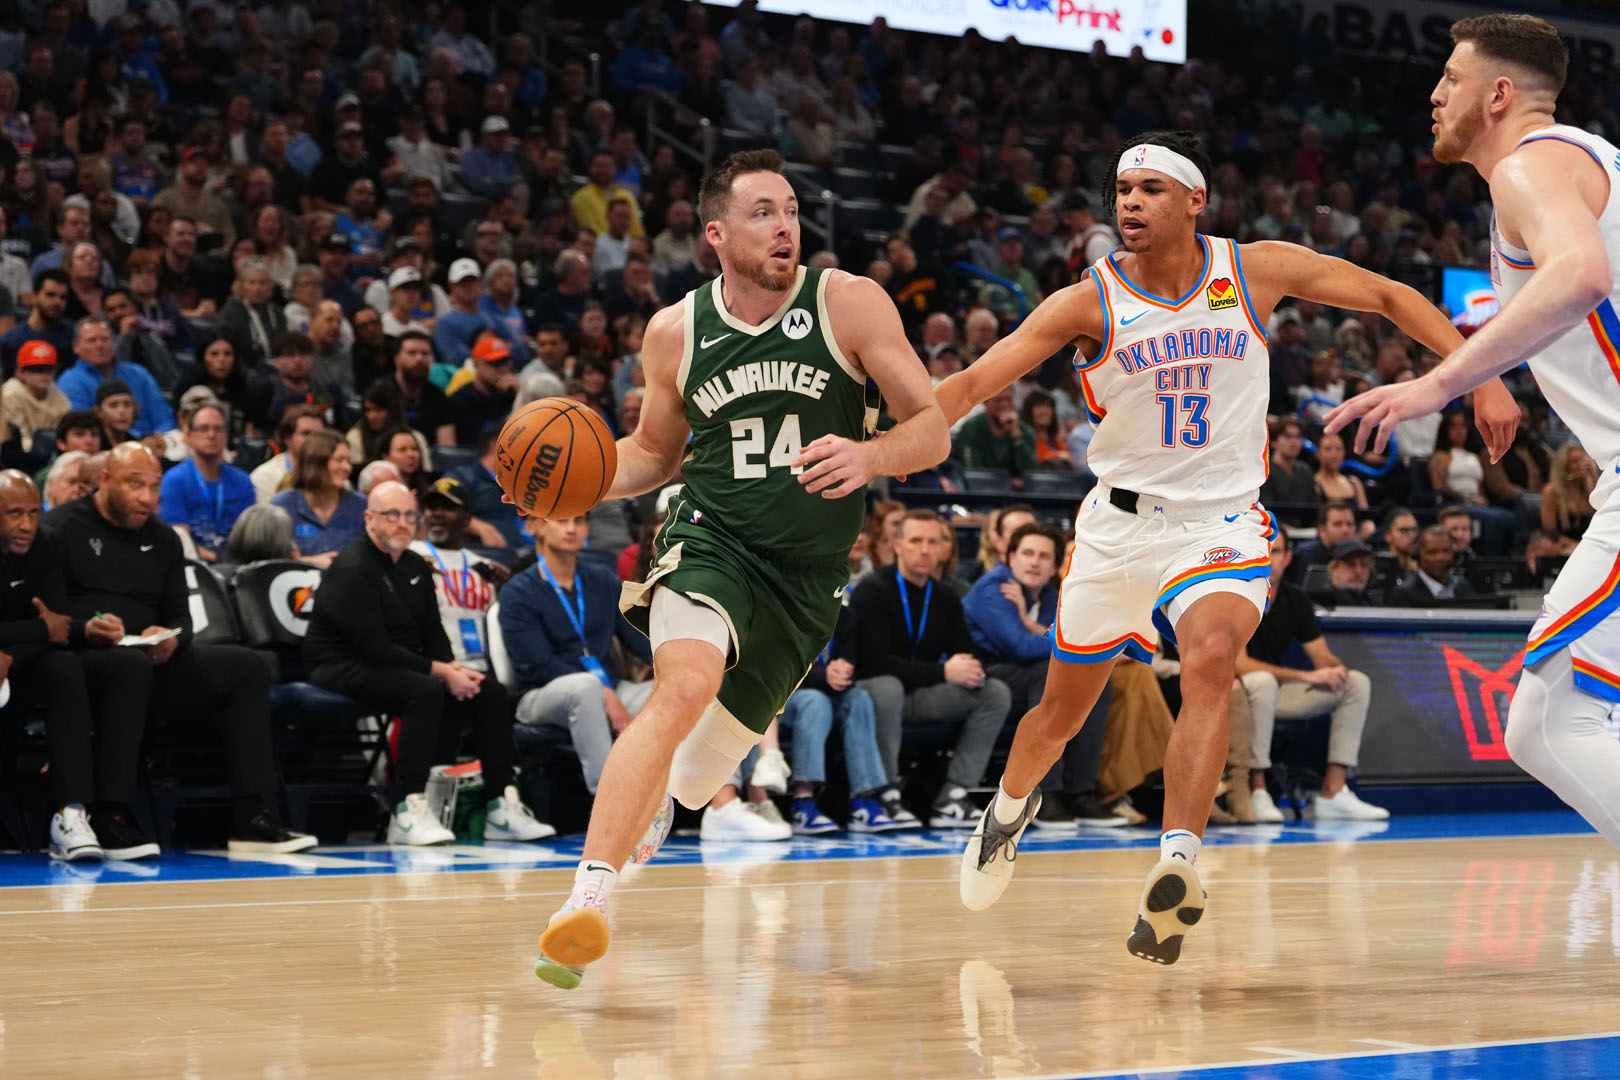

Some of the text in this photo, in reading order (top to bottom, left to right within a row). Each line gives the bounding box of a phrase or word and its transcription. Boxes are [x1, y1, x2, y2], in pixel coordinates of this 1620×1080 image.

[1114, 328, 1249, 375] OKLAHOMA
[1156, 364, 1212, 391] CITY
[692, 361, 831, 418] MILWAUKEE
[730, 414, 804, 480] 24
[1156, 393, 1210, 449] 13
[522, 443, 563, 511] Wilson
